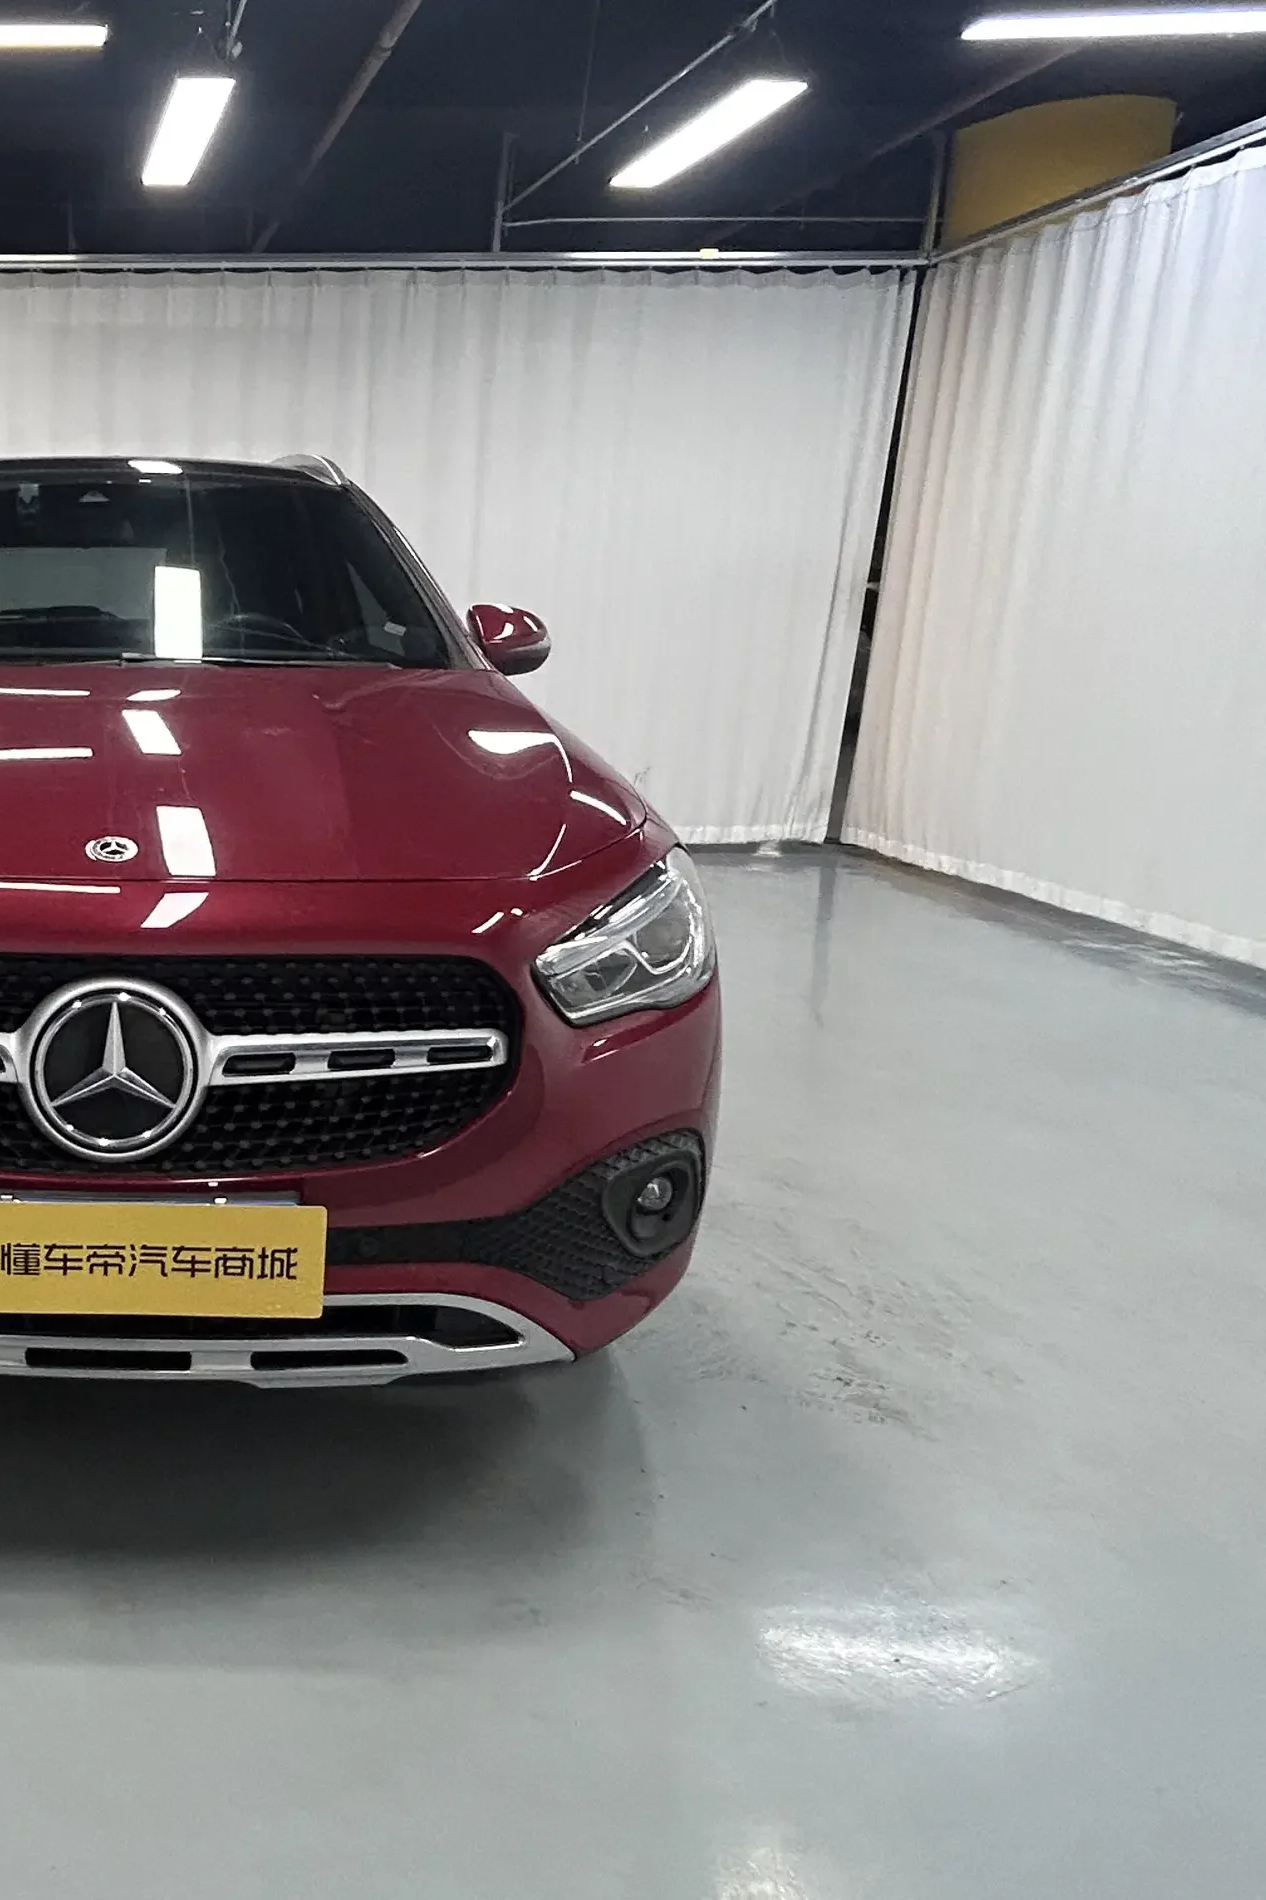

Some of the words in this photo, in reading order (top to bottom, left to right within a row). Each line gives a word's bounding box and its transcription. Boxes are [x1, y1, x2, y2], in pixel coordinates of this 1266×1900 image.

[0, 1242, 298, 1280] 懂车帝汽车商城
